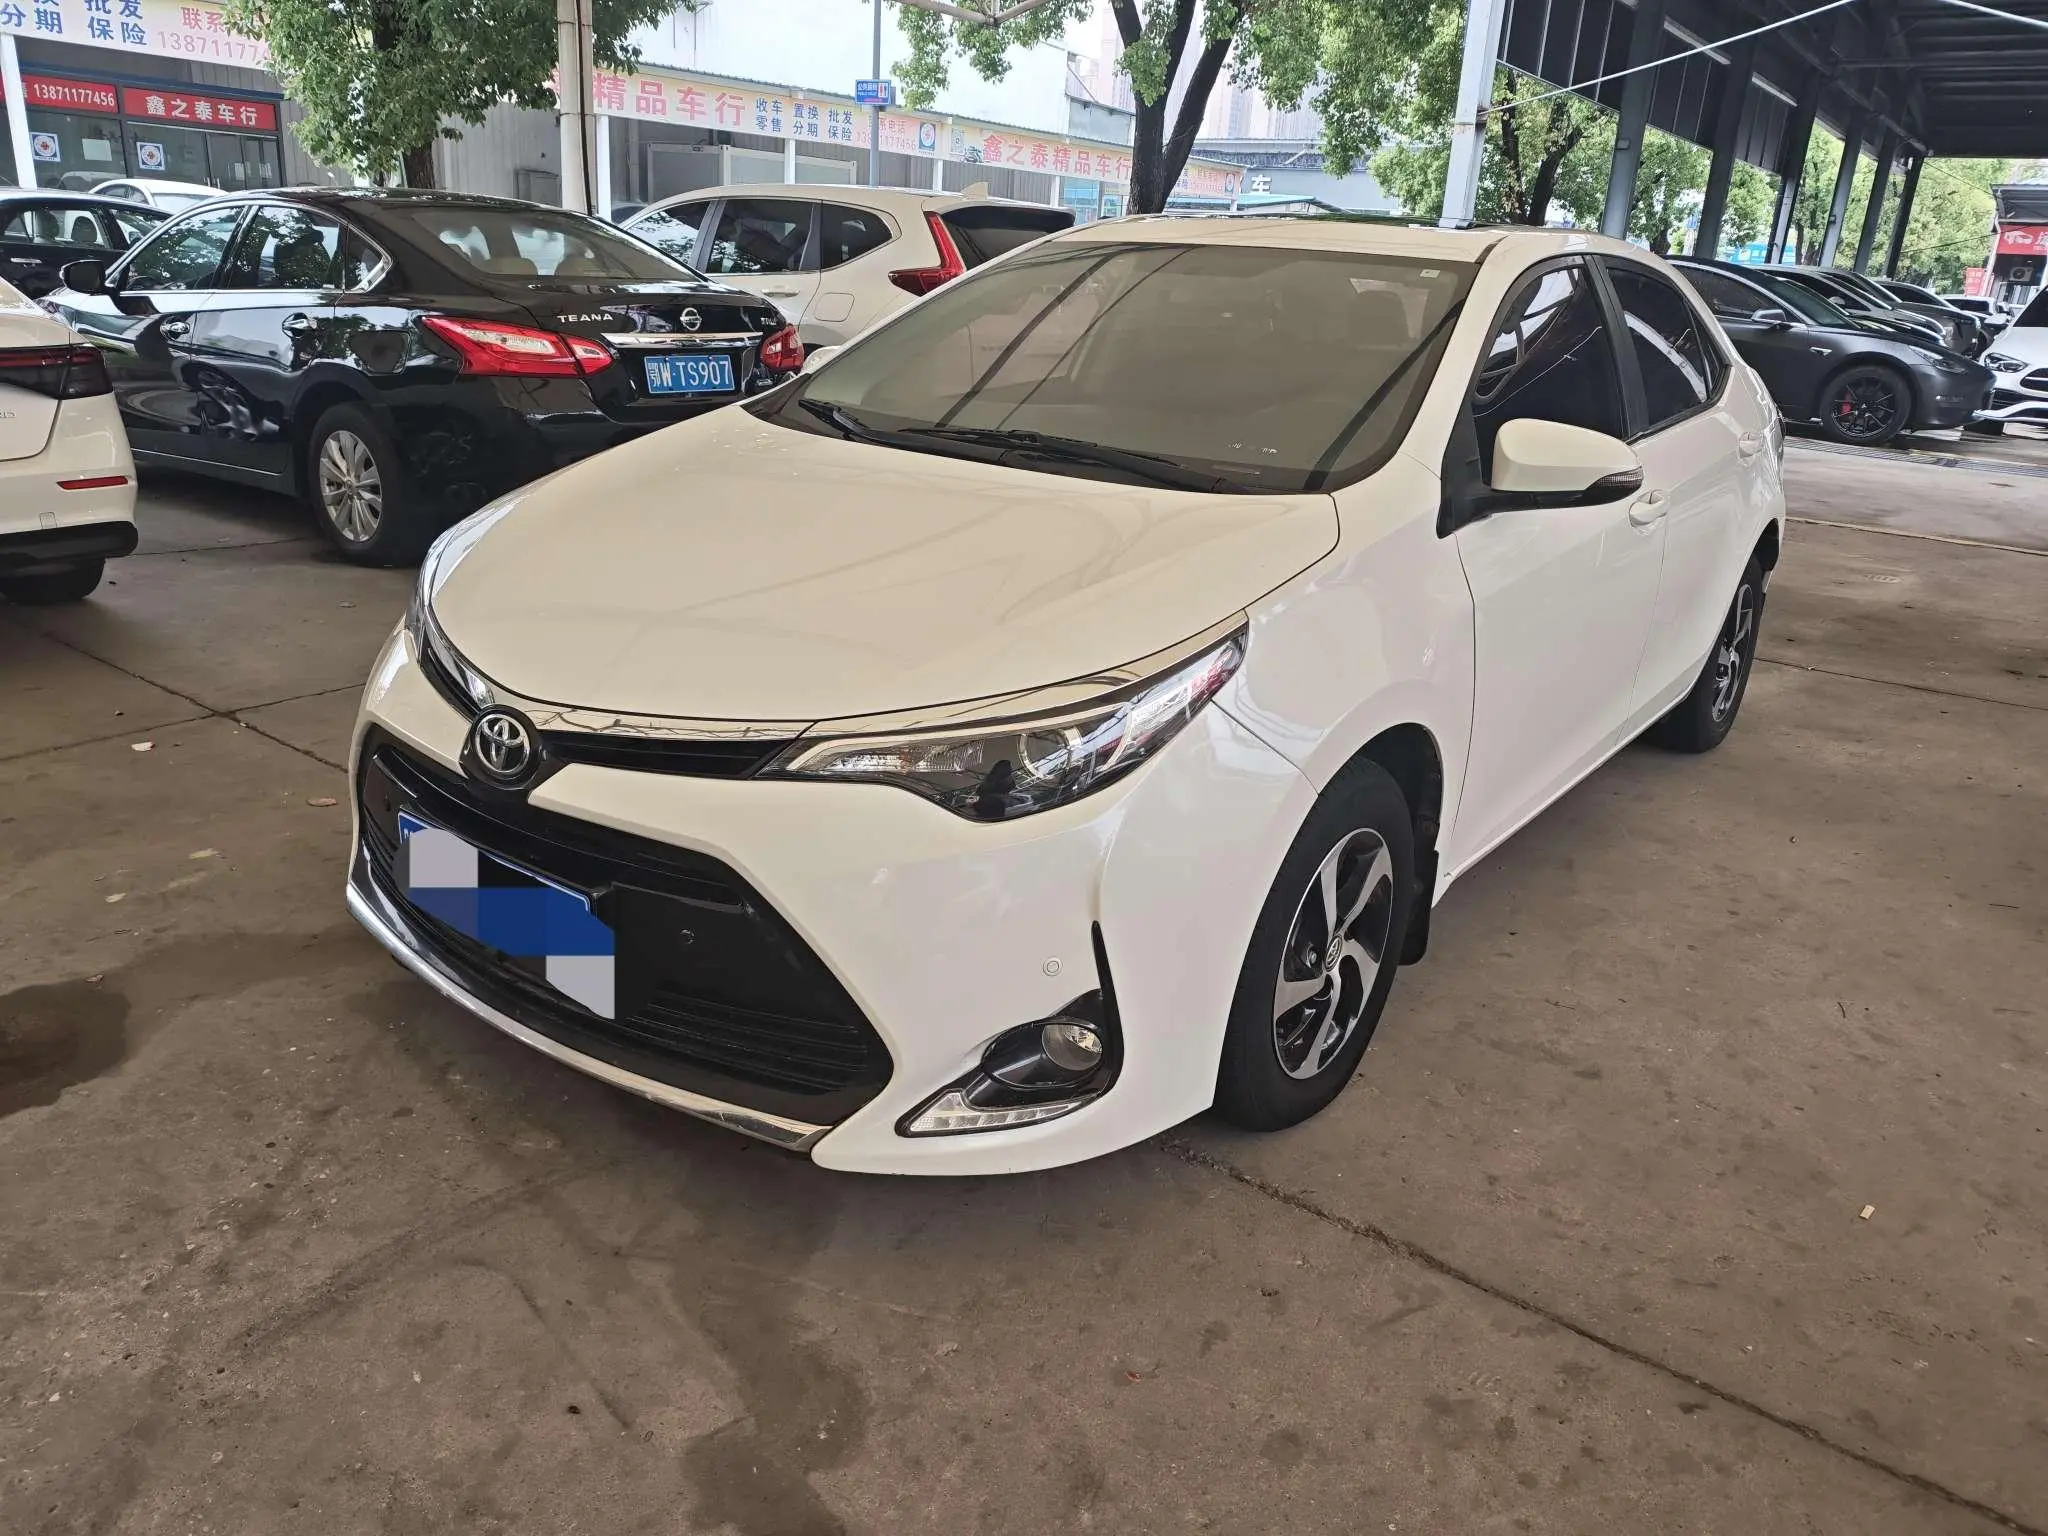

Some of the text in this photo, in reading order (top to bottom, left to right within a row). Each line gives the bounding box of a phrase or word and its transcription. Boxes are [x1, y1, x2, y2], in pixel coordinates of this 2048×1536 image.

[0, 3, 147, 46] 分期 保险
[33, 82, 116, 107] 13871177456
[593, 72, 746, 127] 精品车行
[144, 95, 258, 127] 鑫之泰车行
[756, 97, 853, 125] 收车 置换 批发
[755, 114, 853, 142] 零售 分期 保险
[983, 134, 1132, 181] 鑫之泰精品车行
[557, 313, 614, 323] TEANA
